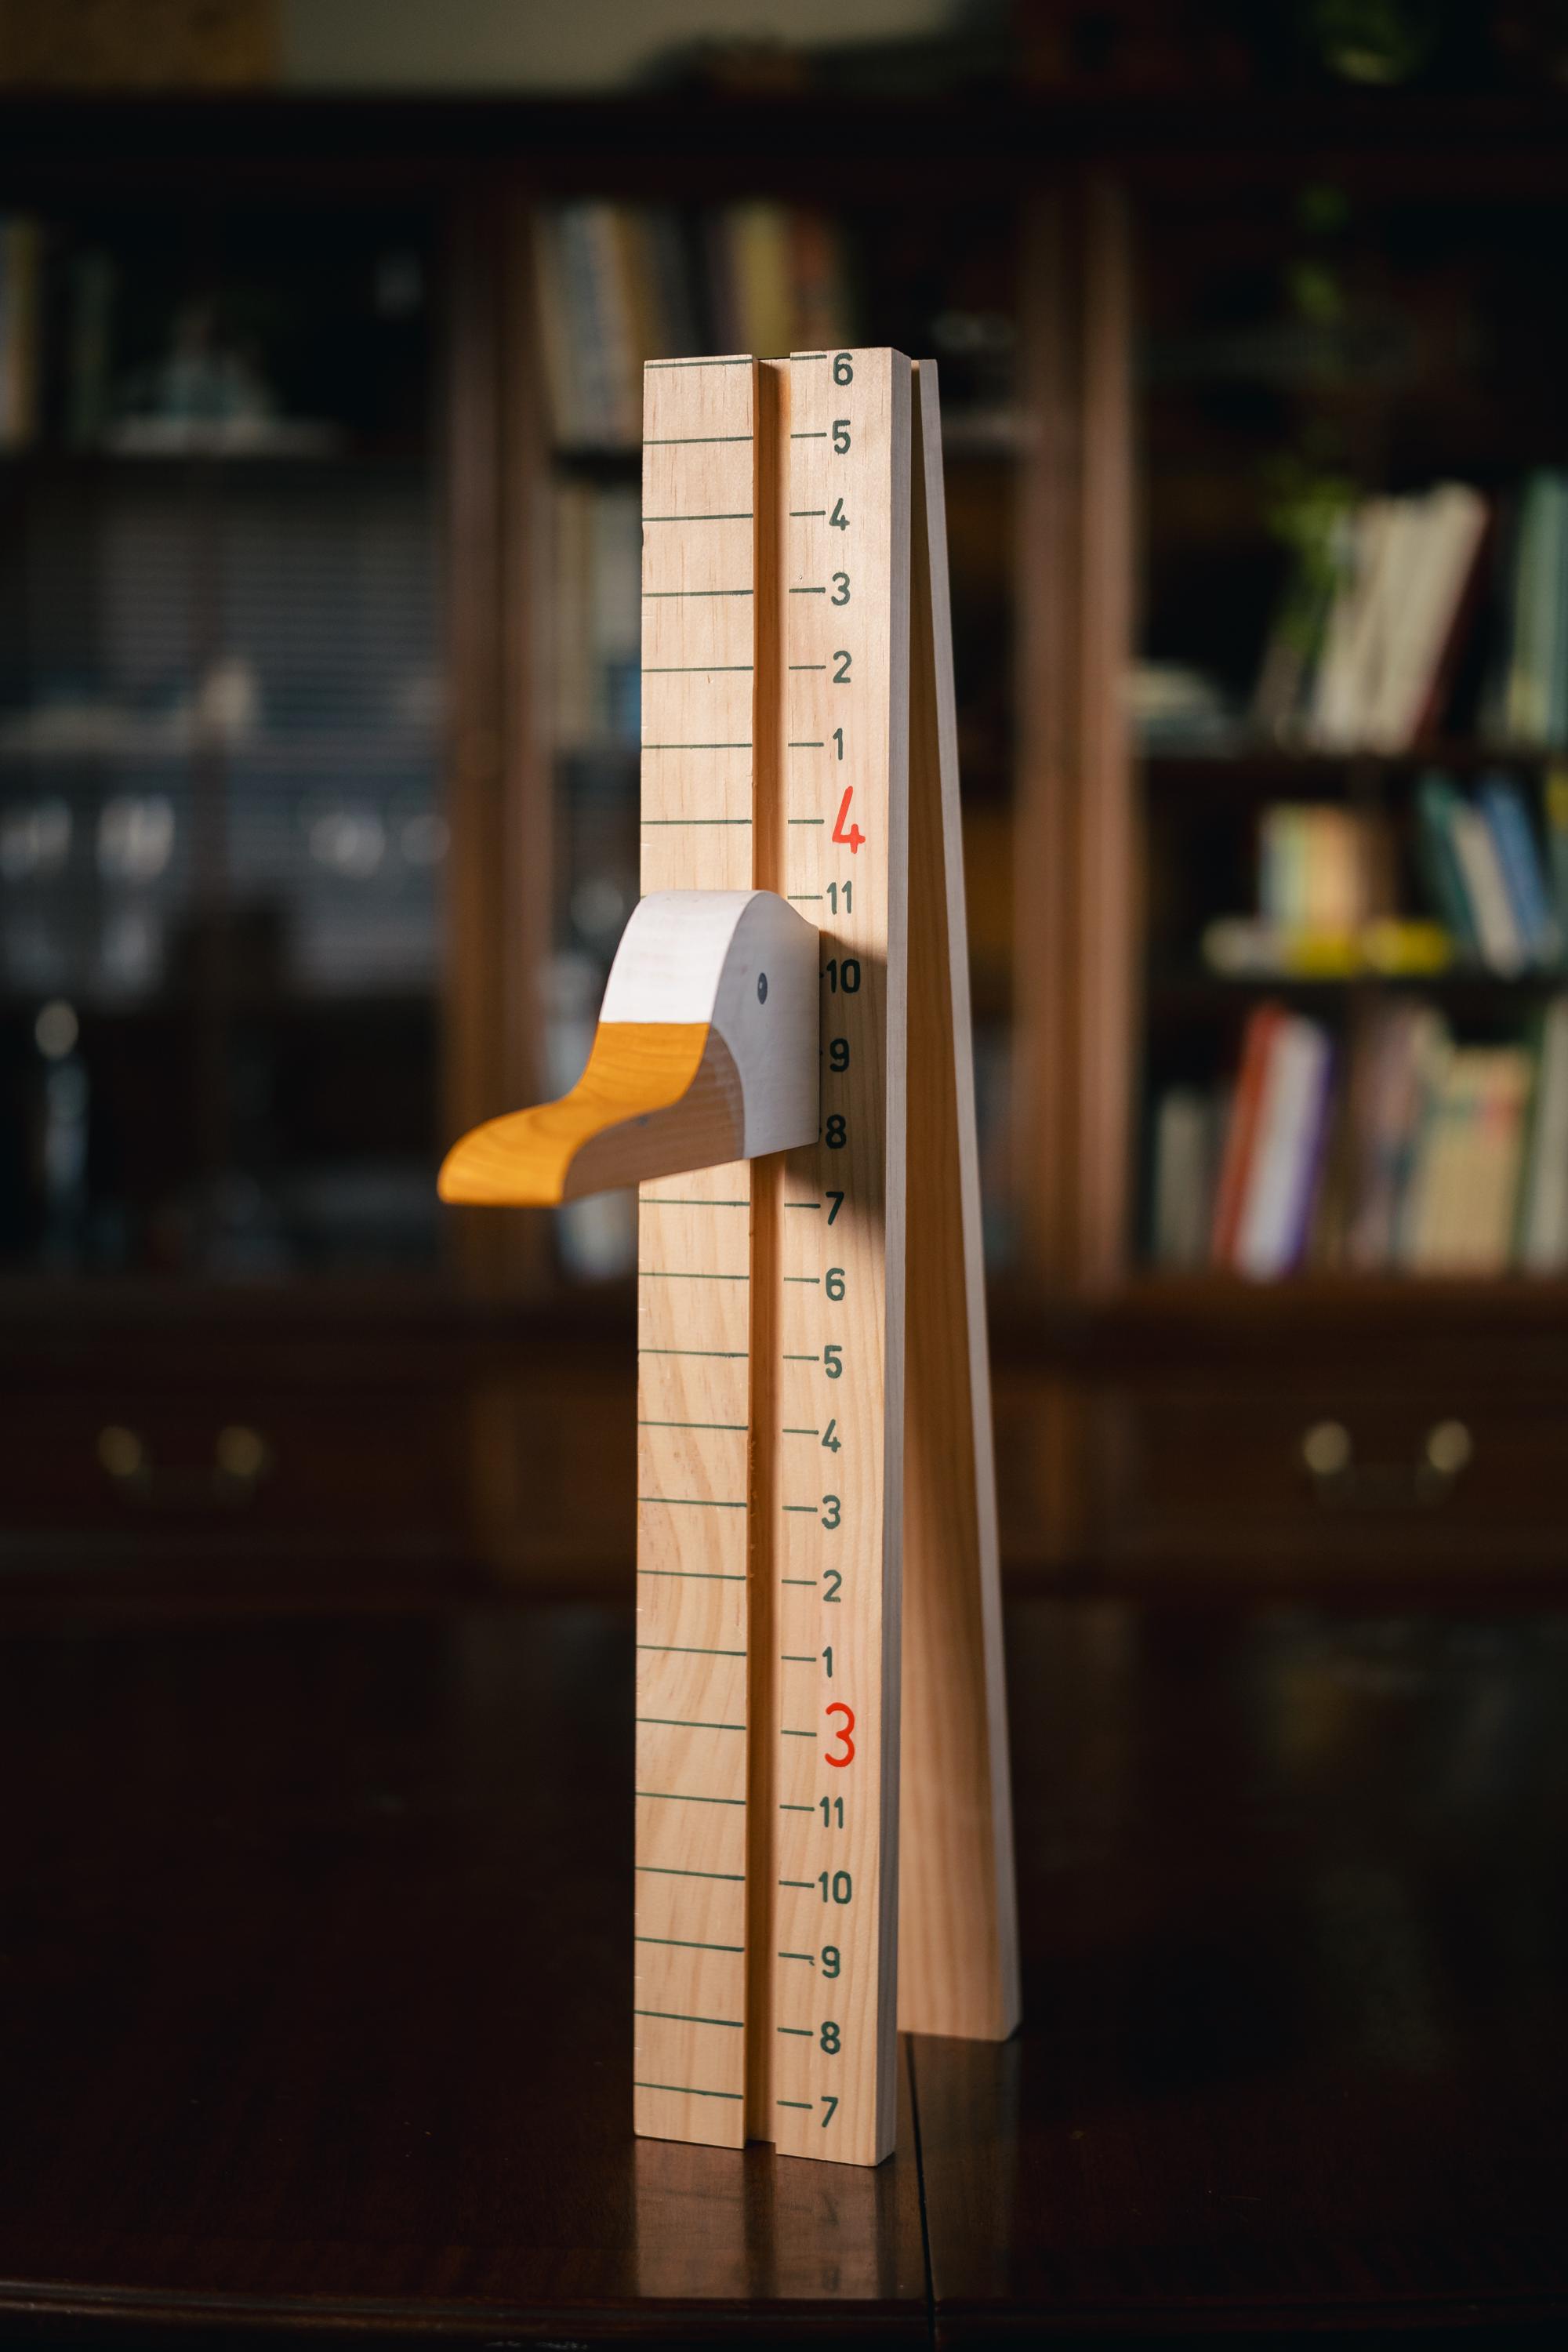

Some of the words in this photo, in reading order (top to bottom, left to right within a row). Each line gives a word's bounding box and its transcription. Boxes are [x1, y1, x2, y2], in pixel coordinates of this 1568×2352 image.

[833, 352, 854, 386] 6
[832, 419, 851, 455] 5
[829, 498, 850, 531] 4
[831, 572, 851, 606] 3
[833, 650, 851, 684] 2
[832, 728, 843, 760] 1
[831, 786, 866, 854] 4
[826, 880, 852, 915] 11
[826, 958, 861, 993] 10
[829, 1037, 849, 1073] 9
[826, 1113, 847, 1149] 8
[826, 1191, 845, 1226] 7
[826, 1267, 846, 1301] 6
[824, 1345, 843, 1379] 5
[822, 1419, 841, 1453] 4
[821, 1494, 841, 1530] 3
[822, 1570, 842, 1602] 2
[822, 1646, 832, 1679] 1
[824, 1701, 855, 1767] 3
[819, 1796, 844, 1828] 11
[818, 1871, 852, 1904] 10
[822, 1945, 840, 1979] 9
[820, 2020, 841, 2055] 8
[821, 2096, 839, 2128] 7
